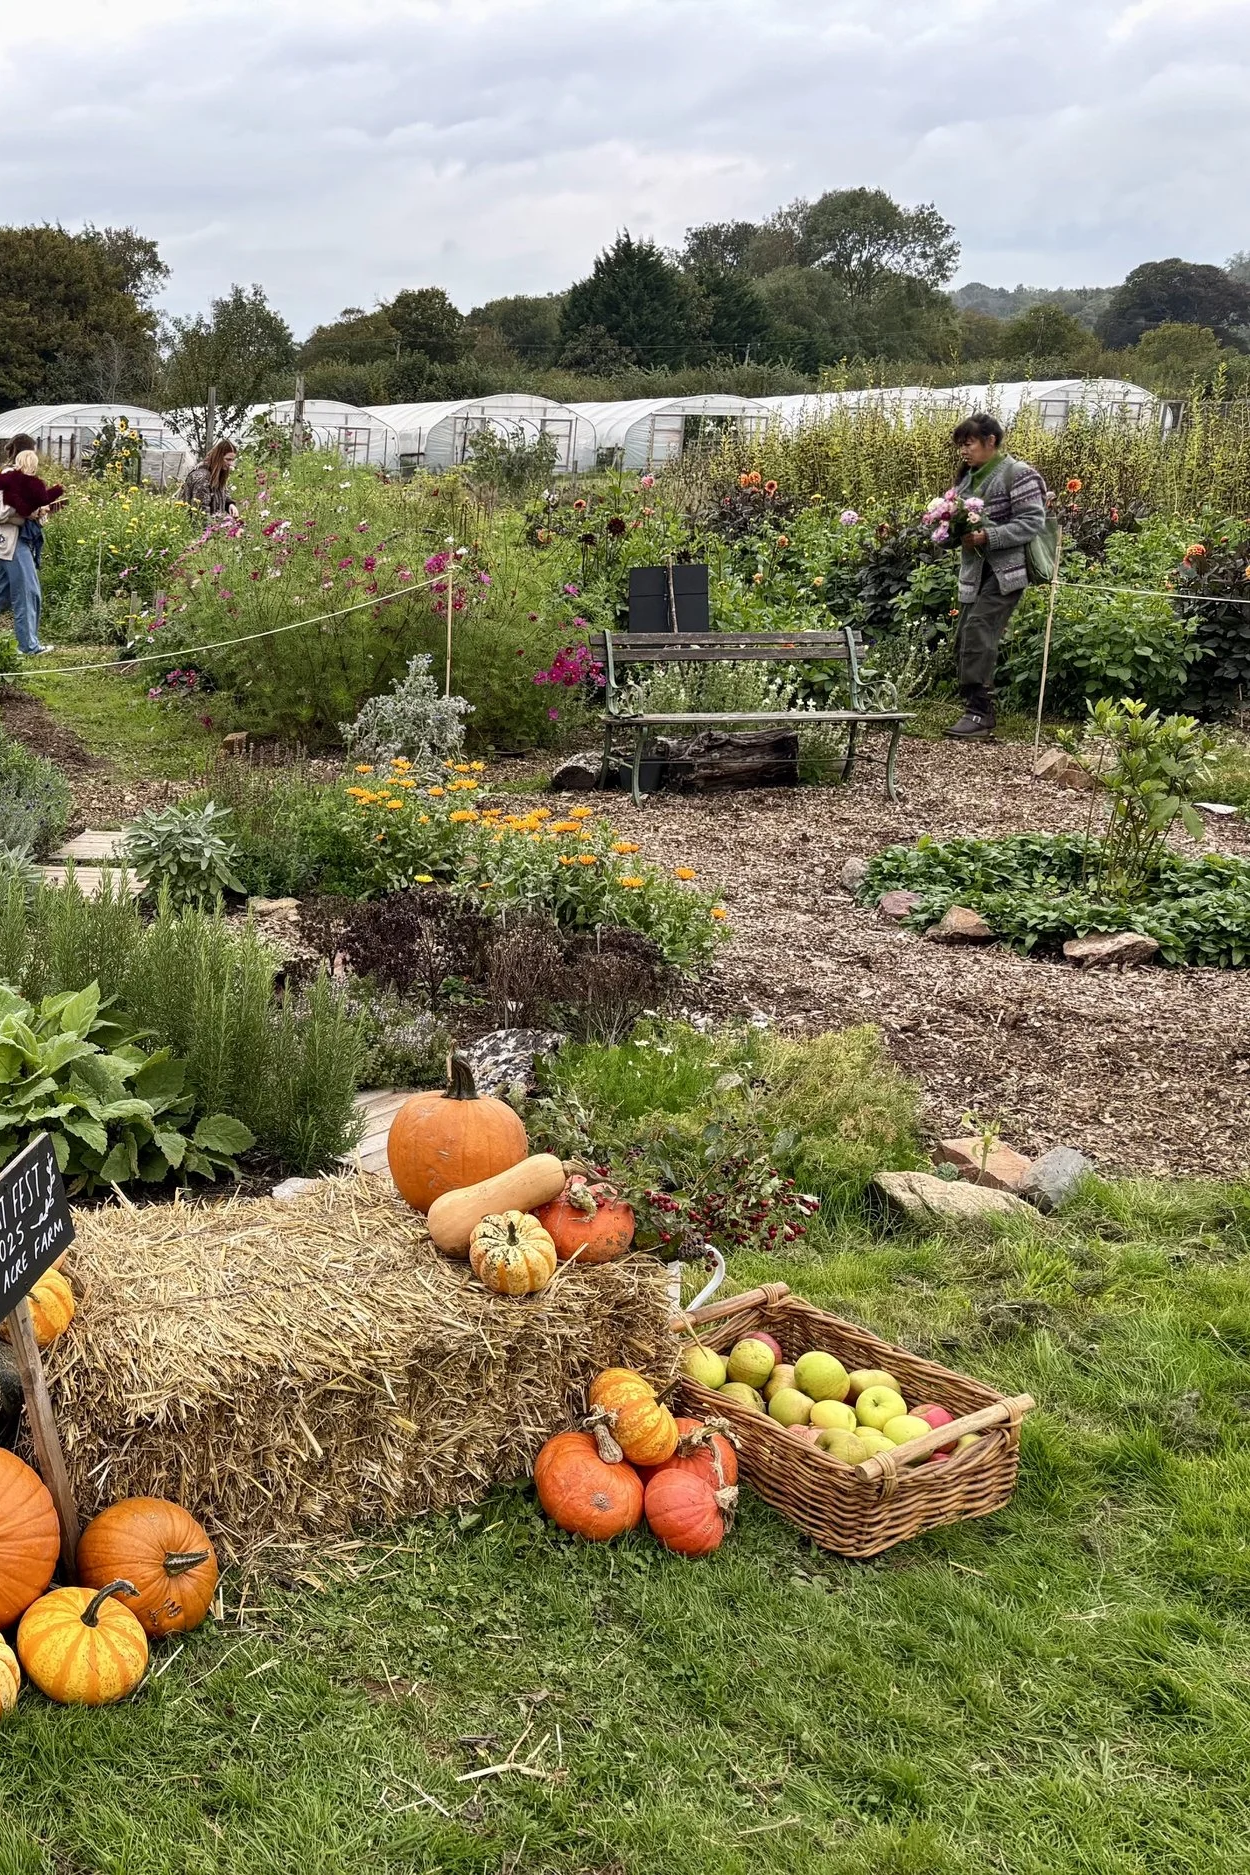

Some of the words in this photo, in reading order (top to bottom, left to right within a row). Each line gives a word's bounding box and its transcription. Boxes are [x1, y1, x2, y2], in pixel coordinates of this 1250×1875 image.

[11, 1162, 40, 1219] FEST
[3, 1255, 29, 1293] ACRE
[34, 1218, 64, 1260] FARM
